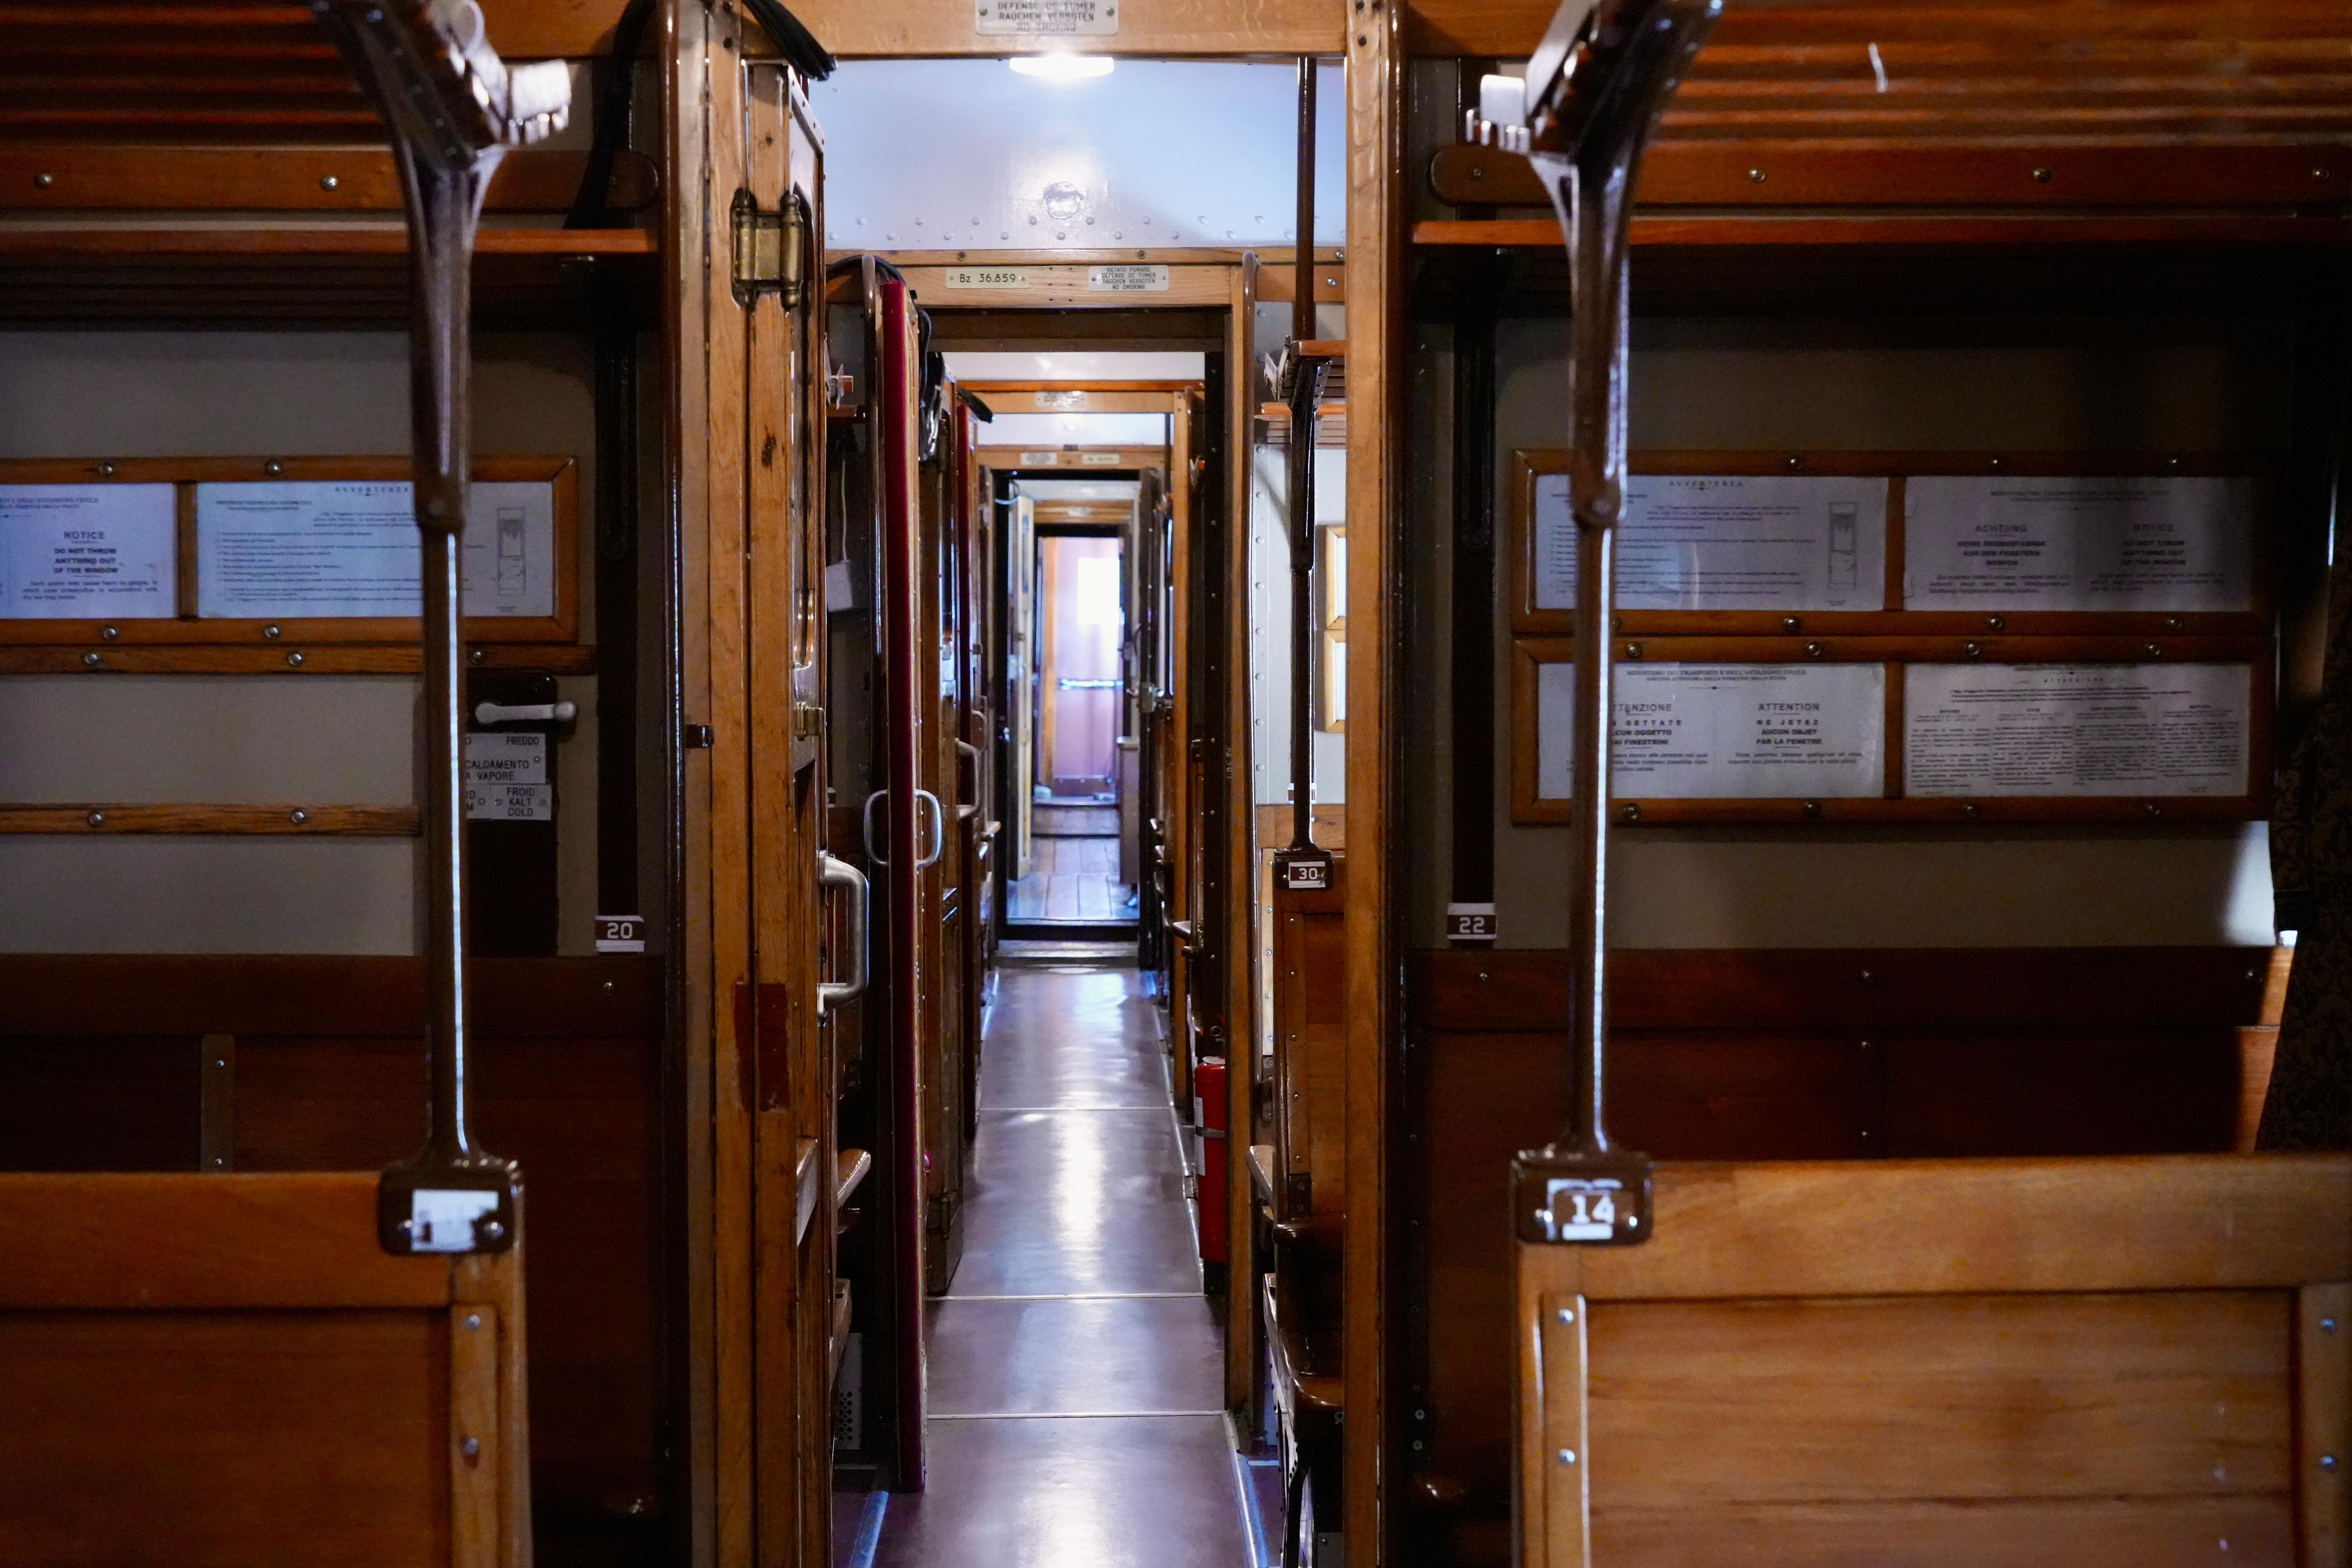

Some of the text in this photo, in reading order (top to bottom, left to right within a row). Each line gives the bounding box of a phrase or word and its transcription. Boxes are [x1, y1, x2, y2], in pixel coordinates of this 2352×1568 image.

[960, 274, 1016, 282] Bz 36.859
[506, 736, 539, 745] FREDDO
[465, 760, 529, 769] CALDAMENTO
[477, 772, 514, 780] VAPORE
[507, 787, 534, 796] FROID
[509, 798, 531, 806] KALT
[508, 808, 533, 816] COLD
[1299, 868, 1317, 880] 30
[1459, 917, 1485, 933] 22
[607, 922, 633, 939] 20
[1572, 1194, 1615, 1224] 14
